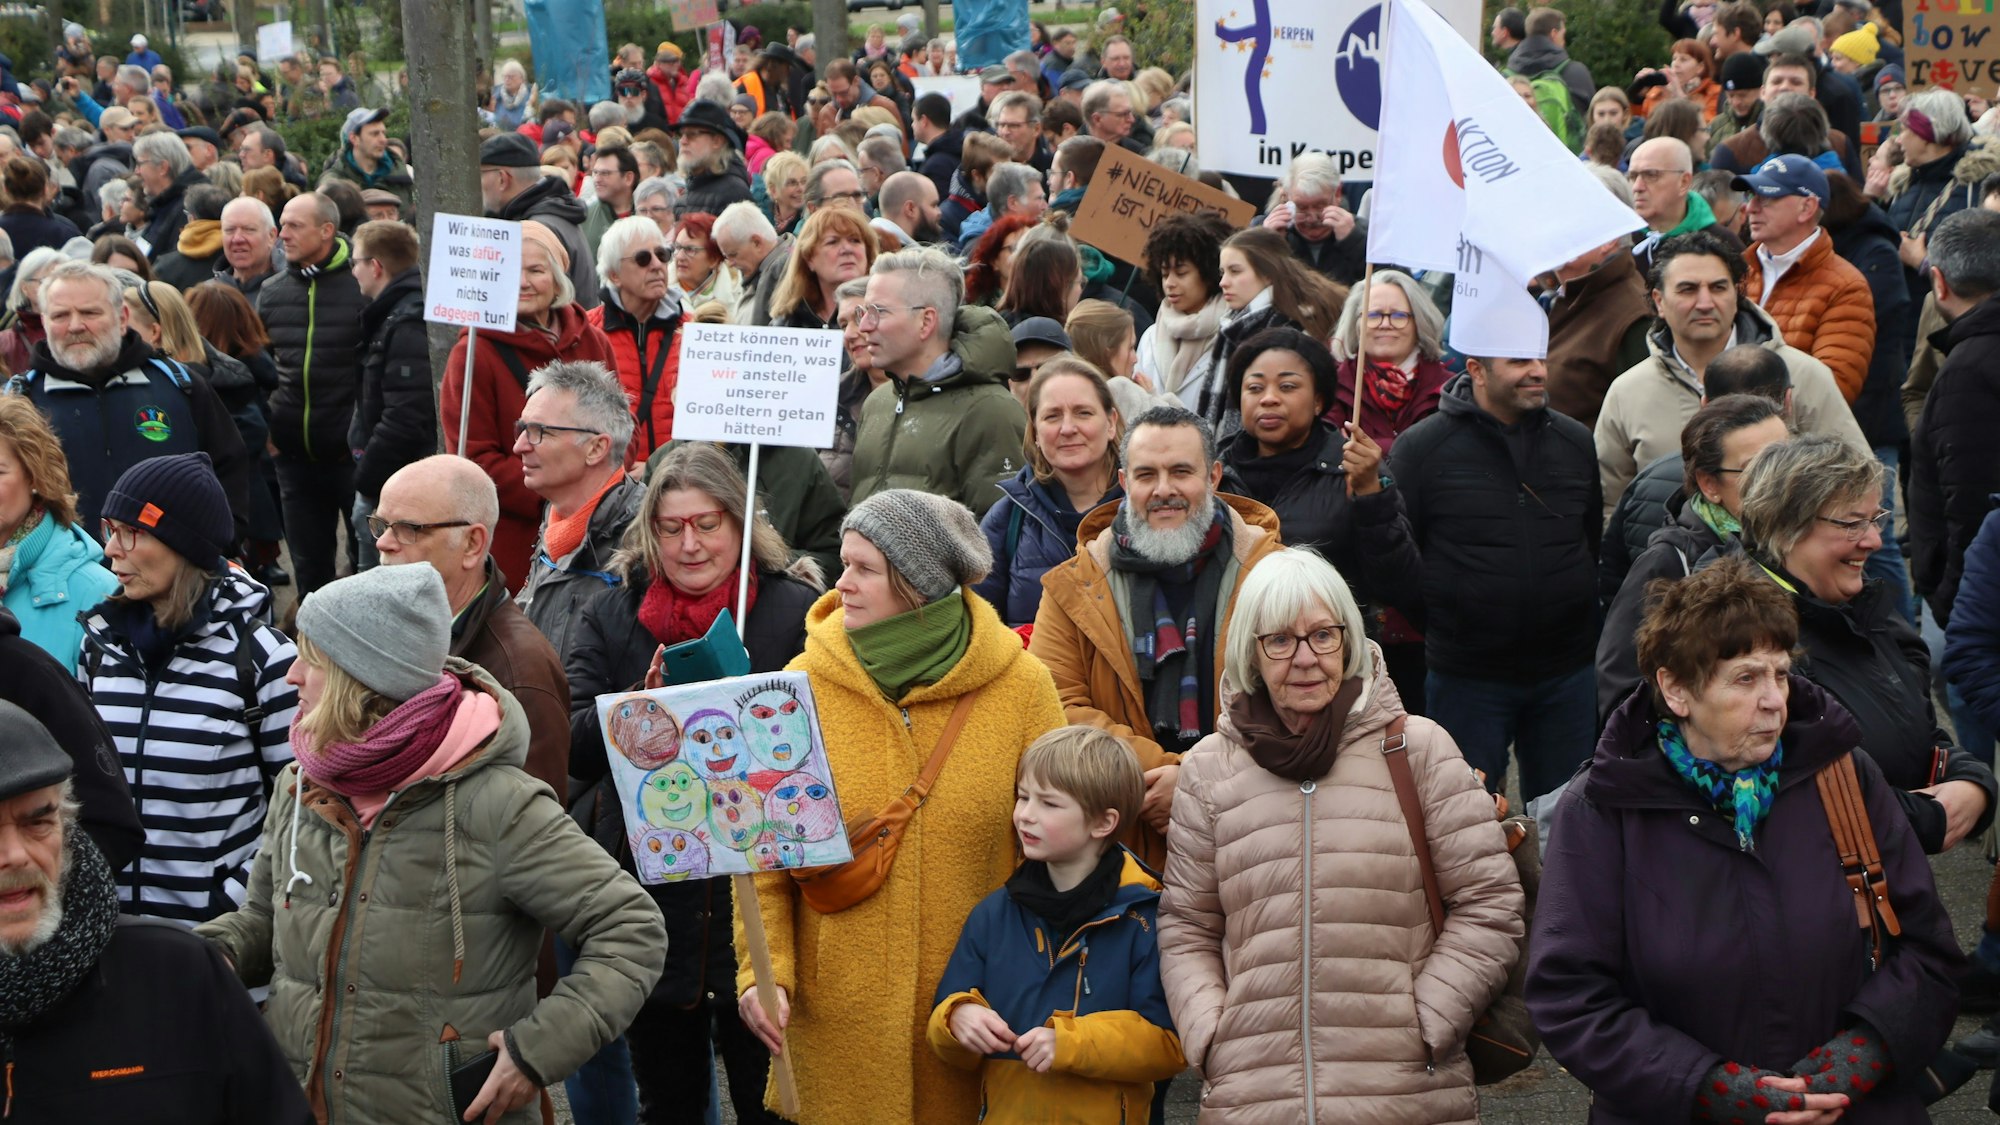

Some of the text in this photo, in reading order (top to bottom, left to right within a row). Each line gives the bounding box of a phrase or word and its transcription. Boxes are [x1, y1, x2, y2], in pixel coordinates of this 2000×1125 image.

[1259, 138, 1282, 165] in
[448, 221, 510, 241] Wir können
[448, 245, 505, 265] was dafür,
[450, 266, 501, 282] wenn wir
[456, 285, 488, 302] nichts
[433, 303, 510, 326] dagegen tun!
[694, 329, 832, 348] Jetzt können wir
[686, 347, 837, 367] herausfinden, was
[711, 367, 807, 383] wir anstelle
[726, 387, 789, 400] unserer
[686, 402, 825, 422] Großeltern getan
[723, 422, 782, 437] hätten!
